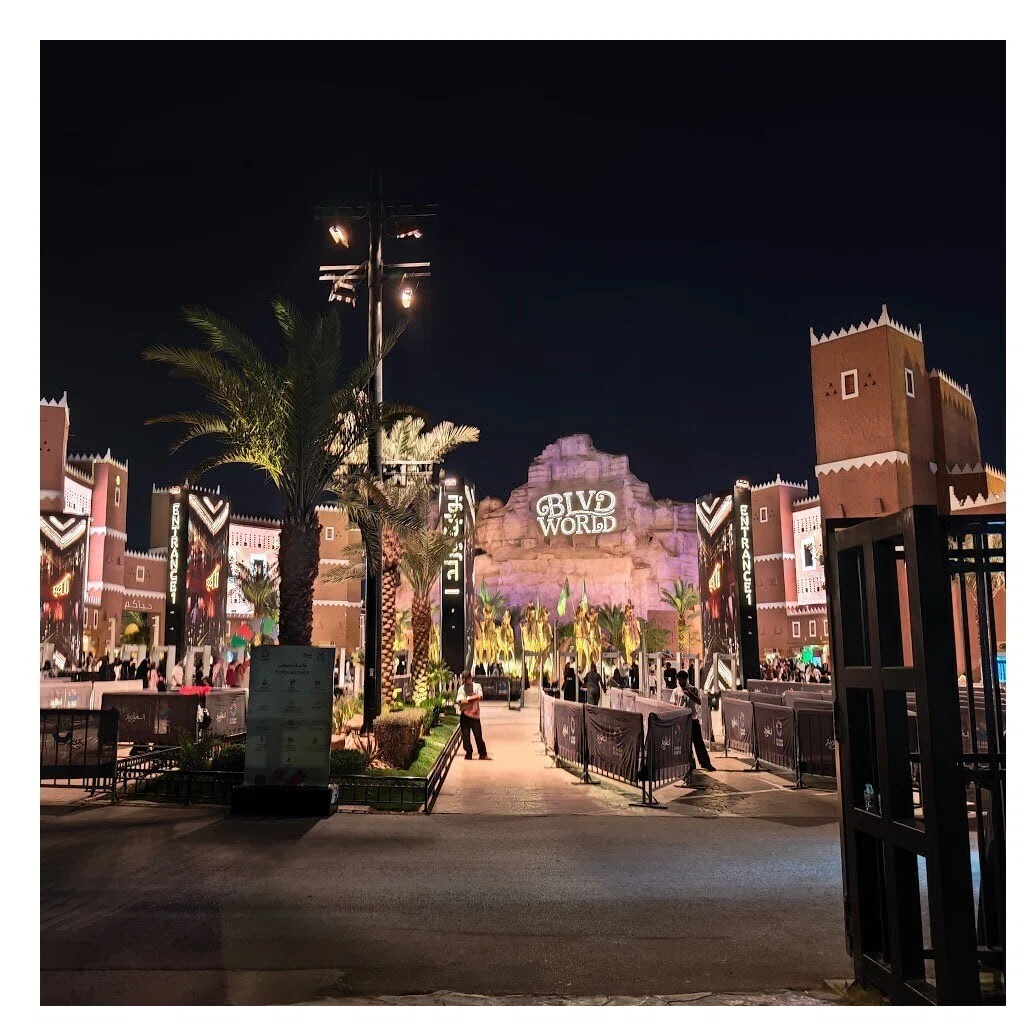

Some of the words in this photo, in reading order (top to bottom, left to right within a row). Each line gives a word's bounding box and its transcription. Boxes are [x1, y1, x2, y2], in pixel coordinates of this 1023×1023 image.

[536, 490, 616, 517] BLVD
[536, 514, 617, 537] WORLD
[740, 504, 752, 594] ENTRANCE
